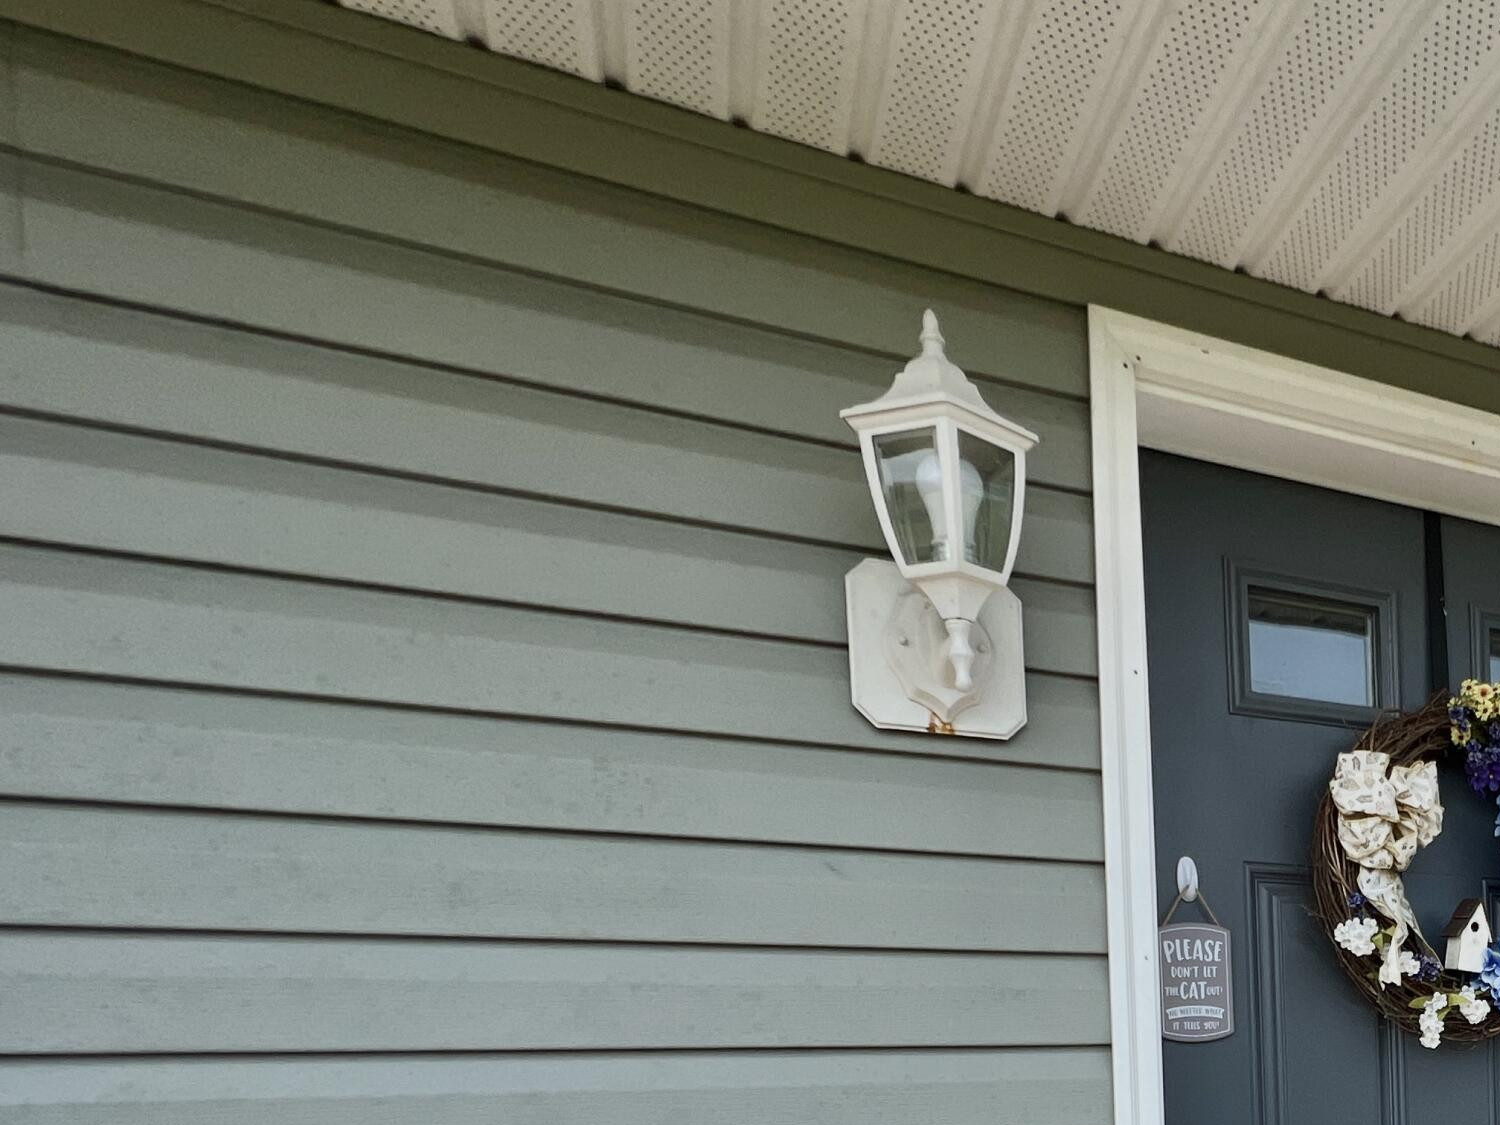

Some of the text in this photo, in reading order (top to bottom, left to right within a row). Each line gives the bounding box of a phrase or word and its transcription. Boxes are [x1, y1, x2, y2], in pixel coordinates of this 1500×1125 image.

[1163, 938, 1223, 963] PLEASE
[1171, 965, 1218, 978] DON'T LET
[1180, 981, 1207, 1000] CAT
[1173, 1021, 1180, 1031] IT
